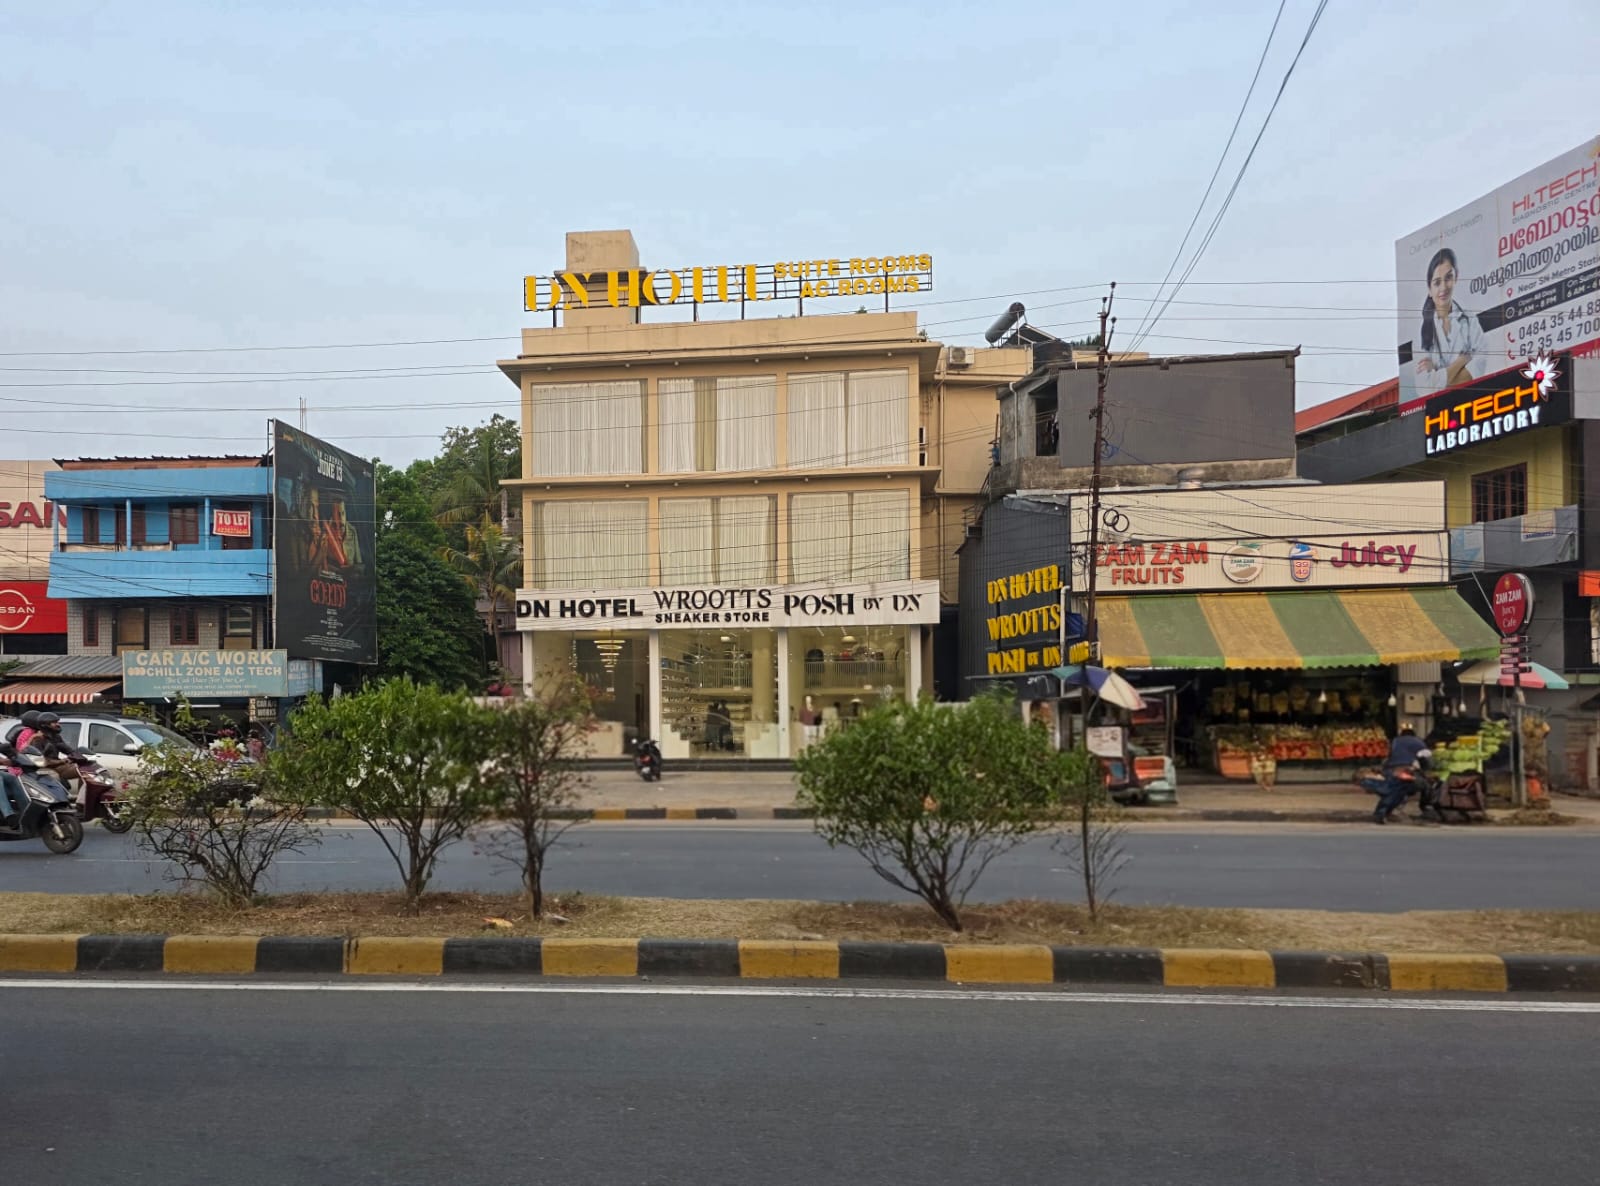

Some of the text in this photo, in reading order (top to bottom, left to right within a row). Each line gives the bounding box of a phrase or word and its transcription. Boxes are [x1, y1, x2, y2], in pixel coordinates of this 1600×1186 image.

[1512, 162, 1597, 216] HI.TECH
[1512, 198, 1561, 225] DIAGNOSTIC
[774, 254, 931, 279] SUITE ROOMS
[607, 264, 772, 307] HOTEL
[799, 276, 919, 298] AC ROOMS
[1518, 281, 1537, 293] Near
[1551, 265, 1576, 278] Metro
[1573, 284, 1585, 295] AM
[1523, 303, 1535, 314] AM
[1546, 295, 1557, 305] PM
[1518, 319, 1547, 340] 0484
[1550, 312, 1565, 328] 35
[1568, 305, 1582, 322] 44
[1519, 341, 1534, 356] 62
[1538, 334, 1552, 350] 35
[1557, 327, 1572, 343] 45
[1425, 381, 1538, 435] HI.TECH
[1426, 405, 1541, 455] LABORATORY
[317, 459, 335, 480] JUNE
[217, 513, 248, 526] TO LET
[1151, 542, 1209, 565] ZAM
[1331, 541, 1417, 574] Juicy
[987, 564, 1063, 604] DN HOTEL
[1112, 567, 1185, 585] FRUITS
[516, 598, 643, 618] DN HOTEL
[653, 588, 772, 611] WROOTTS
[784, 593, 923, 616] POSH BY DN
[1496, 588, 1521, 605] ZAM ZAM
[656, 611, 770, 624] SNEAKER STORE
[987, 603, 1061, 641] WROOTTS
[136, 651, 273, 666] CAR A/C WORK
[987, 648, 1026, 674] POSH
[147, 667, 185, 677] CHILL
[187, 667, 220, 677] ZONE
[224, 667, 244, 676] A/C
[249, 666, 281, 676] TECH
